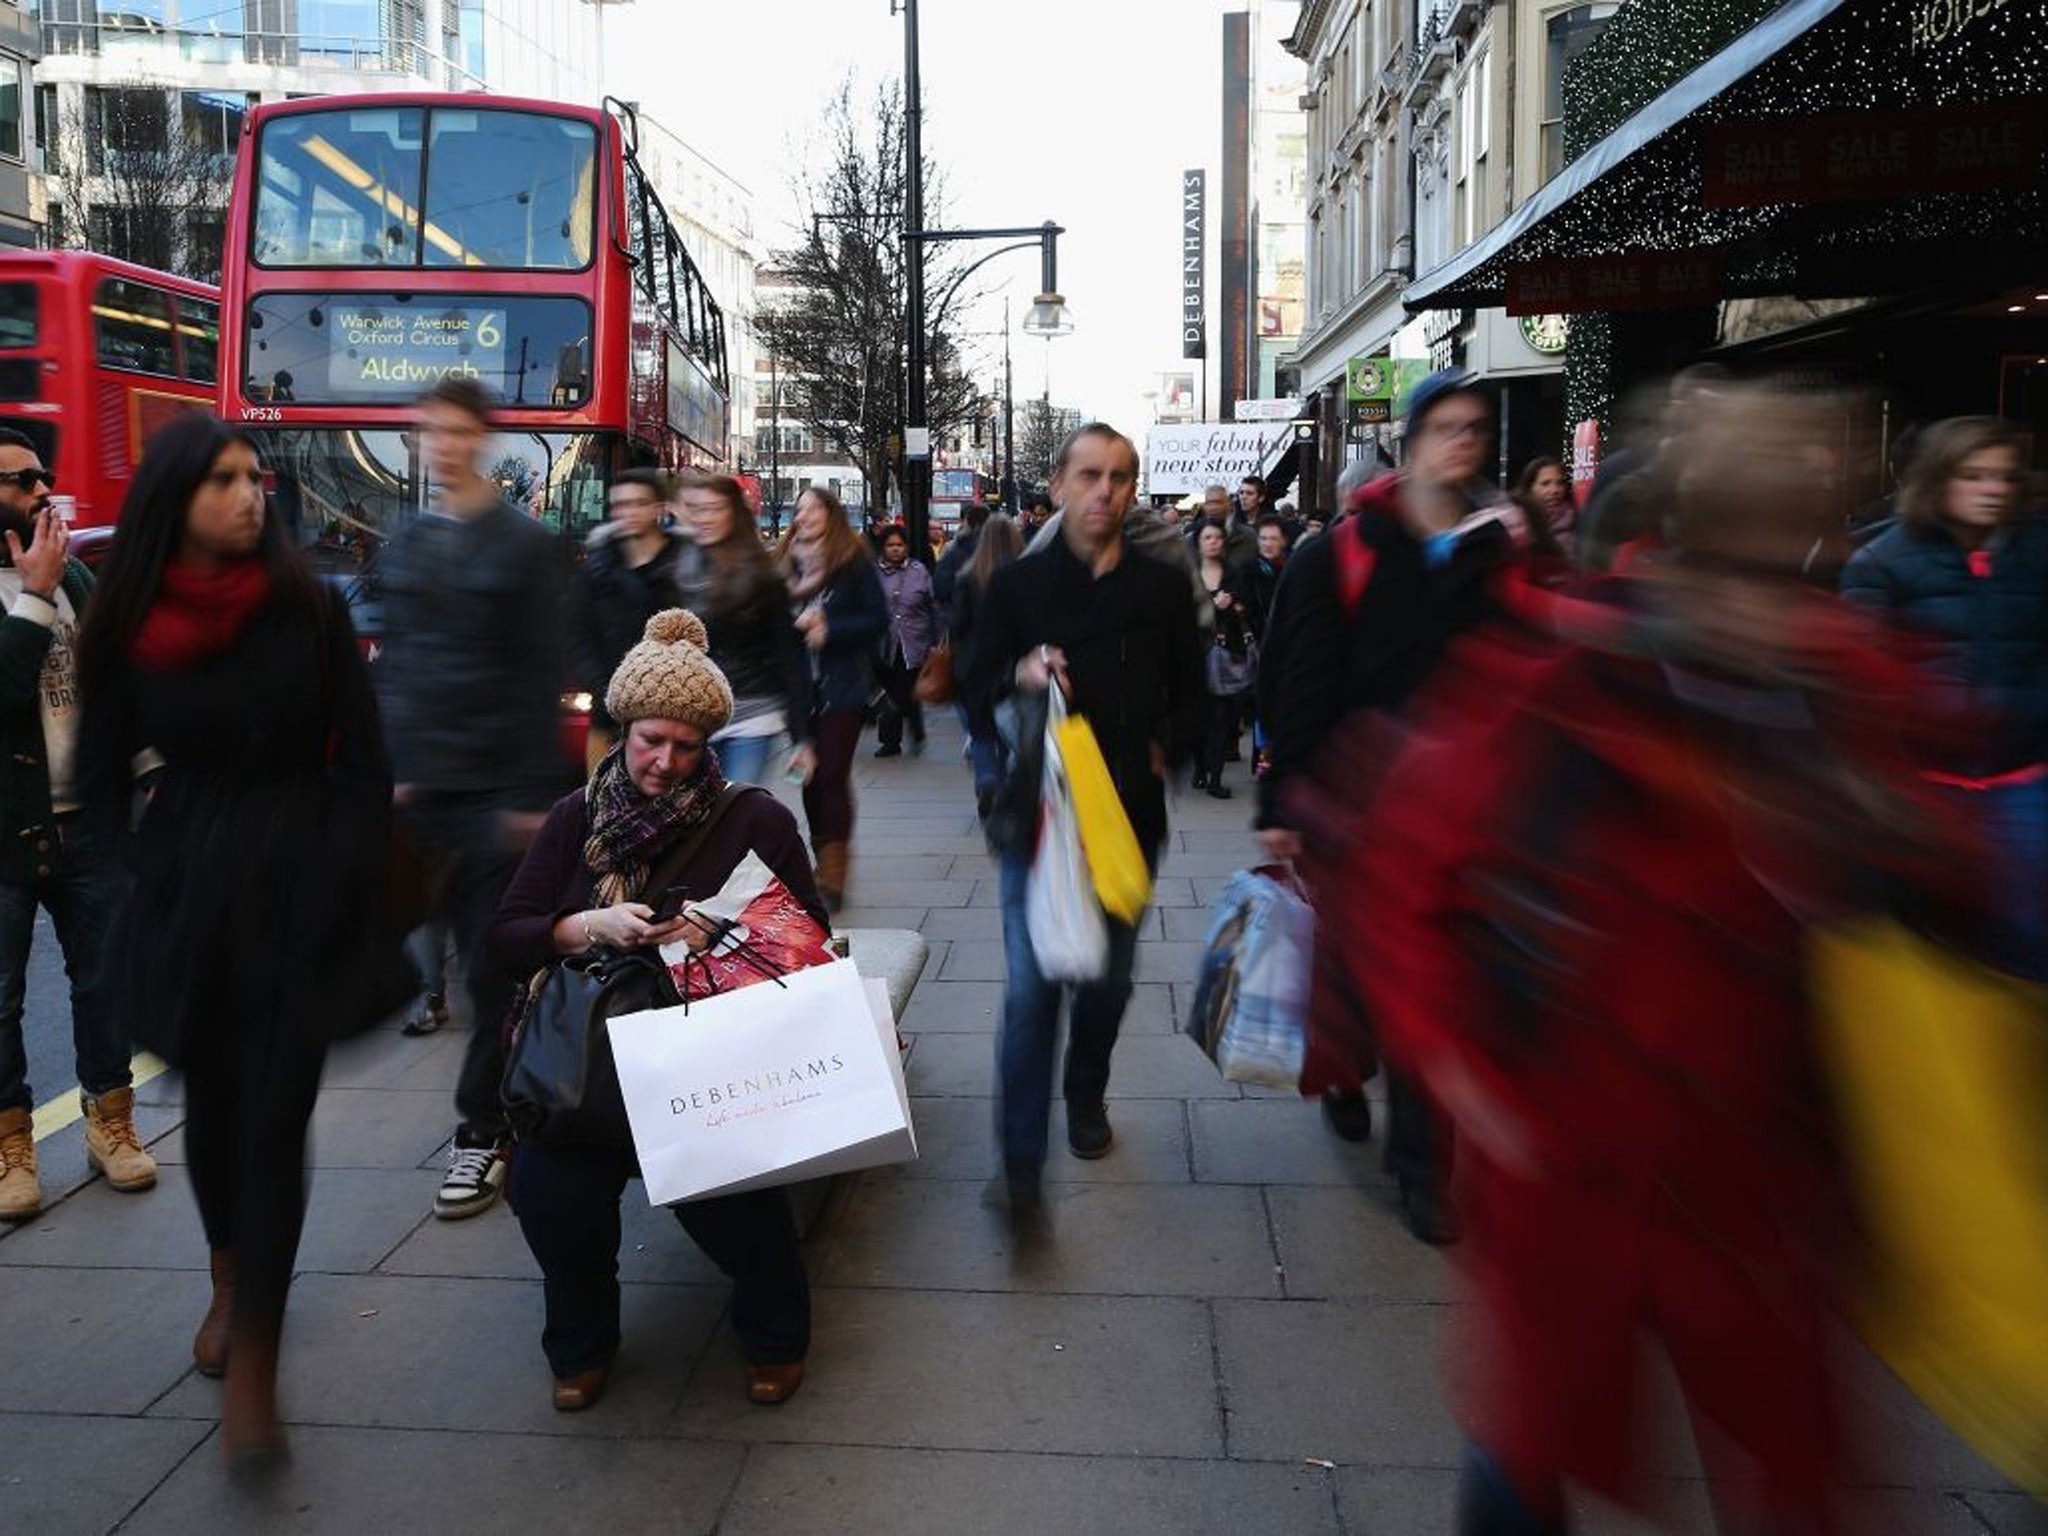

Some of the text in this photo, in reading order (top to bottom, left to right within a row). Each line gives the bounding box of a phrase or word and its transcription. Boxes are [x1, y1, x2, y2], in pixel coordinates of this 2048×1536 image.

[1185, 175, 1201, 342] DEBENHAMS
[340, 313, 500, 347] Warwick Avenue 6
[348, 330, 460, 346] Oxford Circus
[361, 357, 479, 384] Aldwych
[241, 407, 282, 420] VP526
[1160, 440, 1201, 453] YOUR
[1155, 459, 1200, 473] new
[671, 1053, 844, 1115] DEBENHAMS
